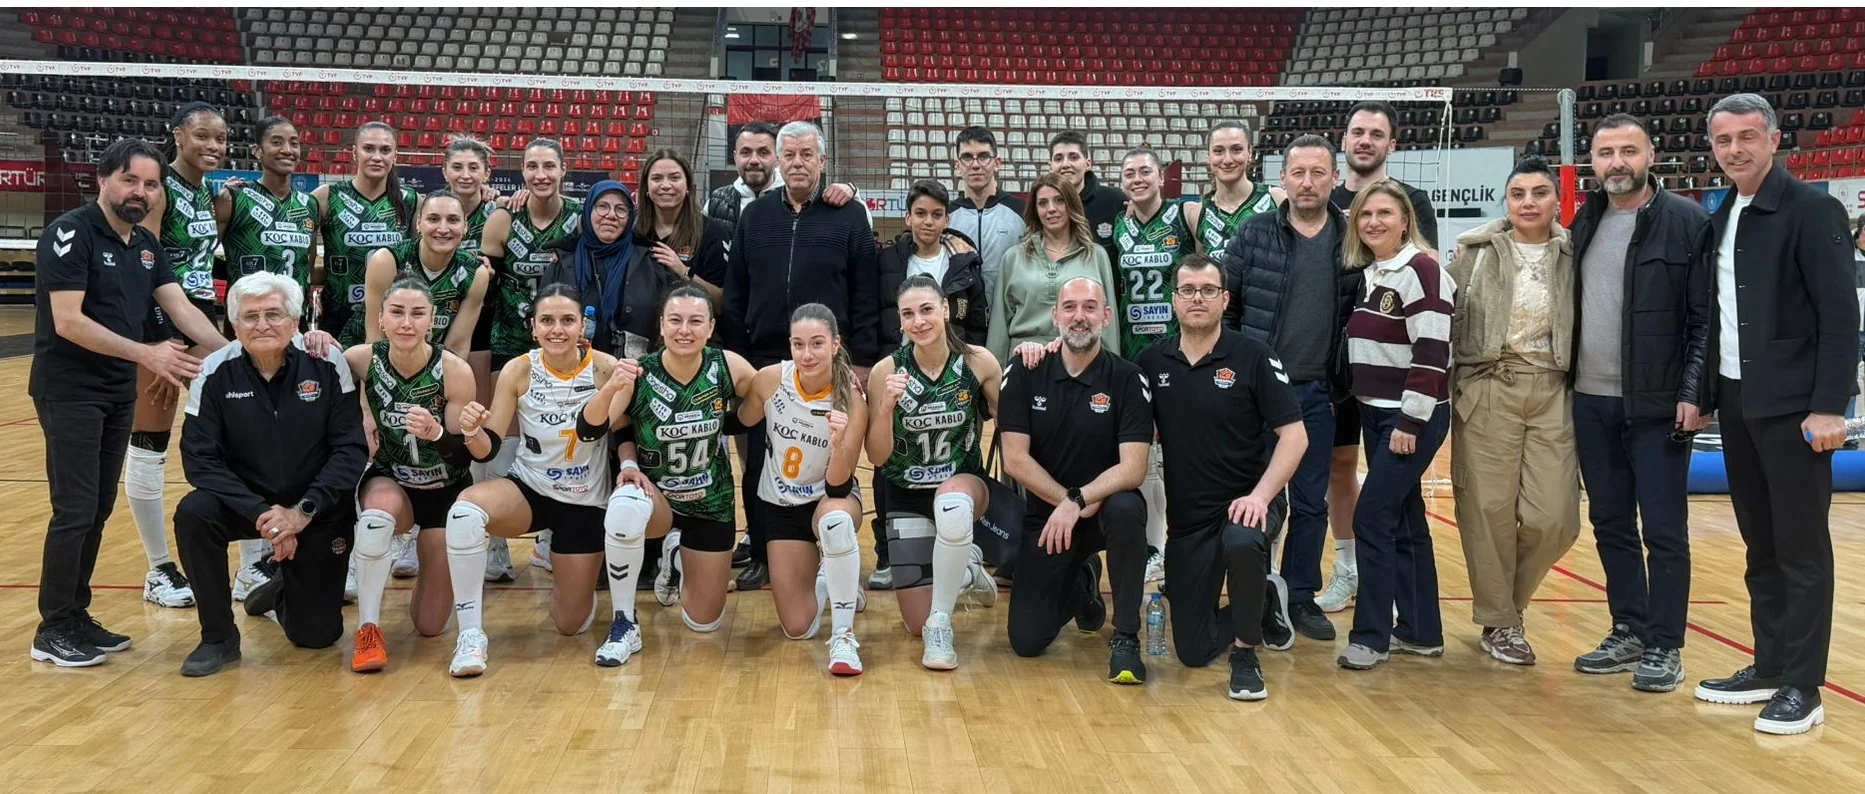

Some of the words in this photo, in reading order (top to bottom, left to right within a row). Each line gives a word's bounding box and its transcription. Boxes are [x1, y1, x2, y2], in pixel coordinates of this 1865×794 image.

[1431, 184, 1496, 206] GENÇLİK
[289, 234, 309, 244] KABLO
[376, 234, 400, 242] KABLO
[1144, 254, 1169, 264] KABLO
[1129, 270, 1164, 301] 22
[1144, 306, 1168, 315] SAYIN
[691, 421, 718, 434] KABLO
[935, 412, 963, 424] KABLO
[404, 434, 419, 465] 1
[558, 428, 578, 462] 7
[800, 432, 828, 448] KABLO
[916, 430, 950, 464] 16
[668, 439, 709, 474] 54
[782, 446, 803, 480] 8
